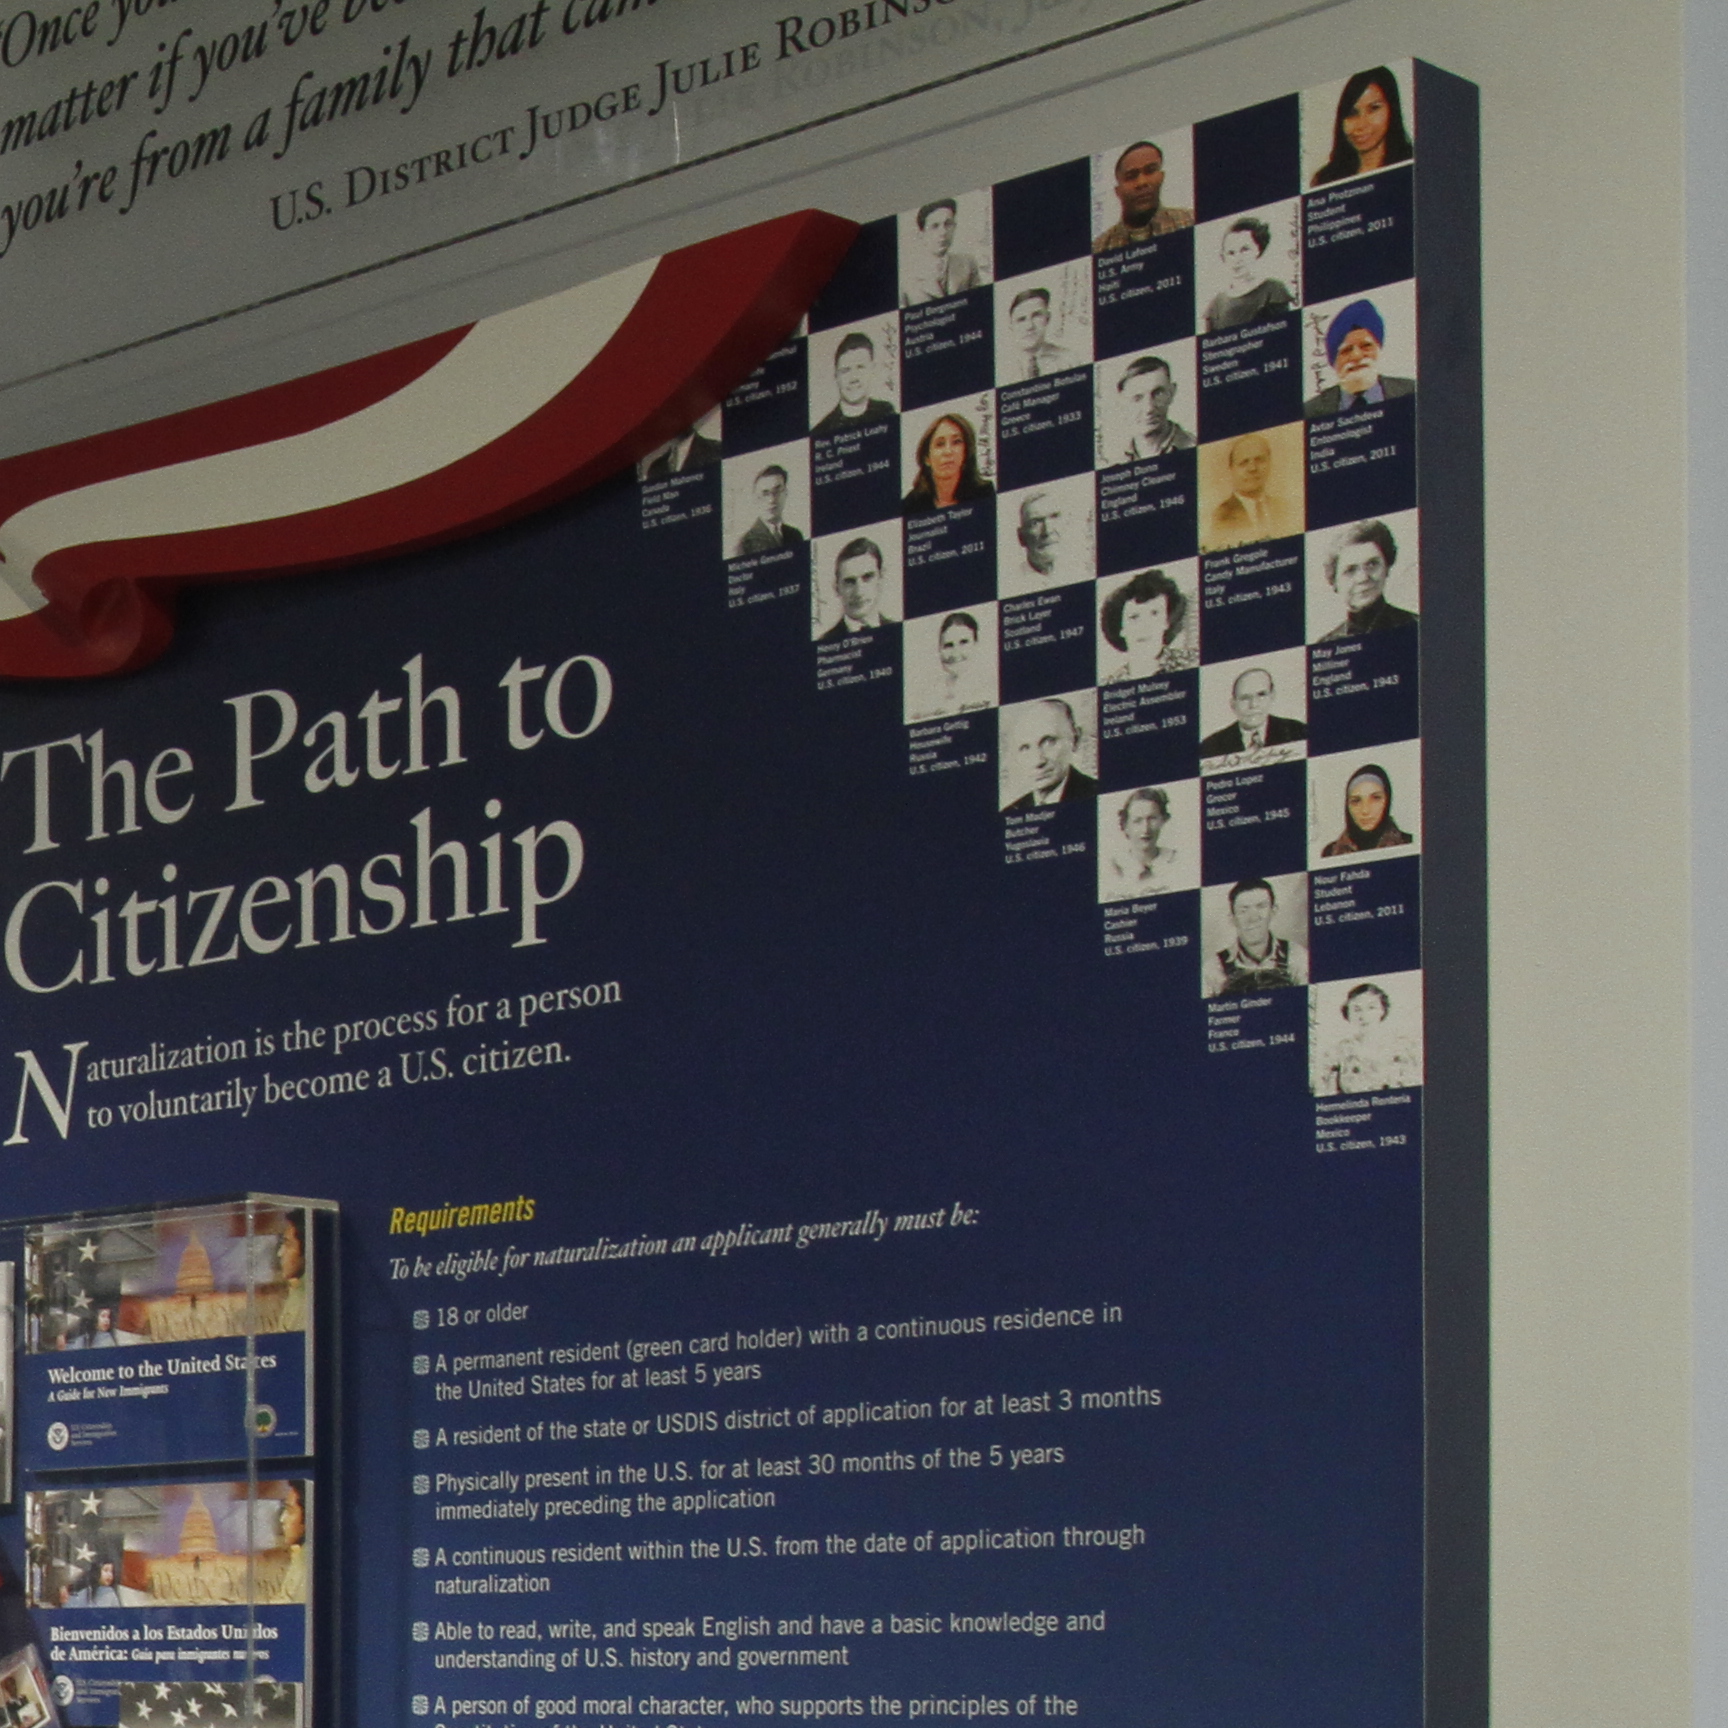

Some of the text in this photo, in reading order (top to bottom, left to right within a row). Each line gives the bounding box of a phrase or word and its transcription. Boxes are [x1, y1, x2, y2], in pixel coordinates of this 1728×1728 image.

[0, 71, 139, 155] matter
[148, 28, 193, 115] if
[120, 117, 232, 215] from
[242, 107, 272, 152] a
[272, 35, 432, 160] family
[447, 0, 551, 78] that
[272, 181, 332, 231] U.S.
[345, 126, 515, 208] DISTRICT
[518, 83, 641, 161] JUDGE
[647, 41, 761, 117] JULIE
[0, 653, 613, 854] The Path to
[4, 798, 584, 994] Citizenship
[1314, 885, 1352, 899] Student
[1314, 899, 1355, 913] Lebanon
[1314, 904, 1404, 926] U.S. citizen, 2011
[255, 1027, 275, 1056] is
[282, 1019, 326, 1052] the
[334, 1009, 438, 1055] process
[446, 993, 489, 1028] for
[496, 998, 512, 1020] a
[519, 981, 622, 1028] person
[87, 1040, 571, 1129] to voluntarily become a U.S. citizen.
[389, 1195, 535, 1237] Requirements
[391, 1201, 980, 1282] To be eligible for naturalization an applicant generally must be:
[435, 1302, 1123, 1376] A permanent resident (green card holder) with a continuous residence in
[437, 1302, 529, 1327] 18 or older
[47, 1365, 115, 1384] Welcome
[118, 1366, 135, 1380] to
[138, 1359, 163, 1378] the
[167, 1353, 221, 1376] United
[50, 1624, 130, 1642] Bienvenidos
[131, 1629, 141, 1641] a
[143, 1624, 164, 1641] los
[166, 1623, 218, 1640] Estados
